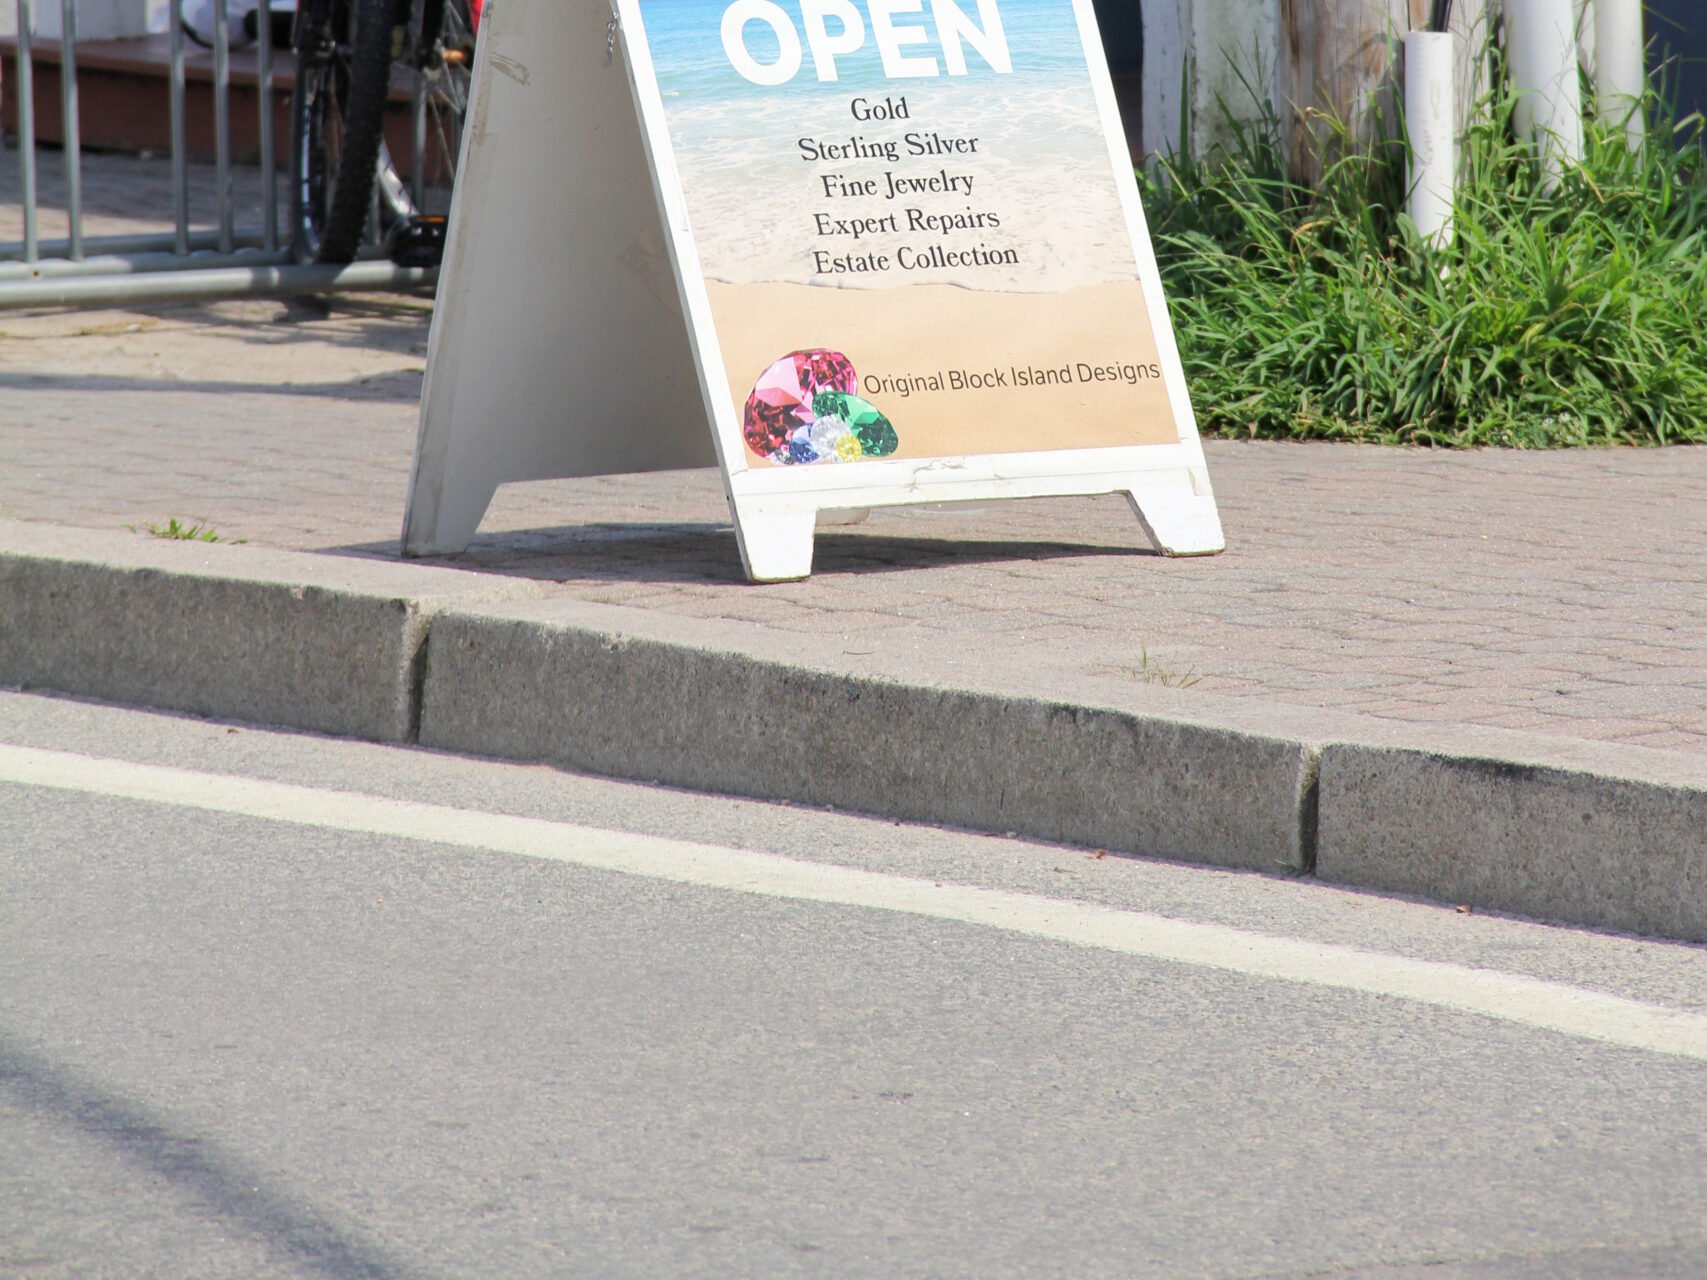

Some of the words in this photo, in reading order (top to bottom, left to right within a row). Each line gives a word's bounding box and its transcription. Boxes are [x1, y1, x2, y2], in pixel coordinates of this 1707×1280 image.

[850, 96, 910, 122] Gold
[797, 135, 900, 162] Sterling
[904, 132, 979, 156] Silver
[819, 174, 878, 198] Fine
[883, 169, 974, 200] Jewelry
[812, 212, 899, 240] Expert
[904, 205, 1001, 235] Repairs
[811, 250, 890, 274] Estate
[896, 242, 1020, 270] Collection
[863, 371, 945, 398] Original
[948, 367, 1008, 390] Block
[1011, 363, 1073, 387] Island
[1076, 363, 1161, 385] Designs
